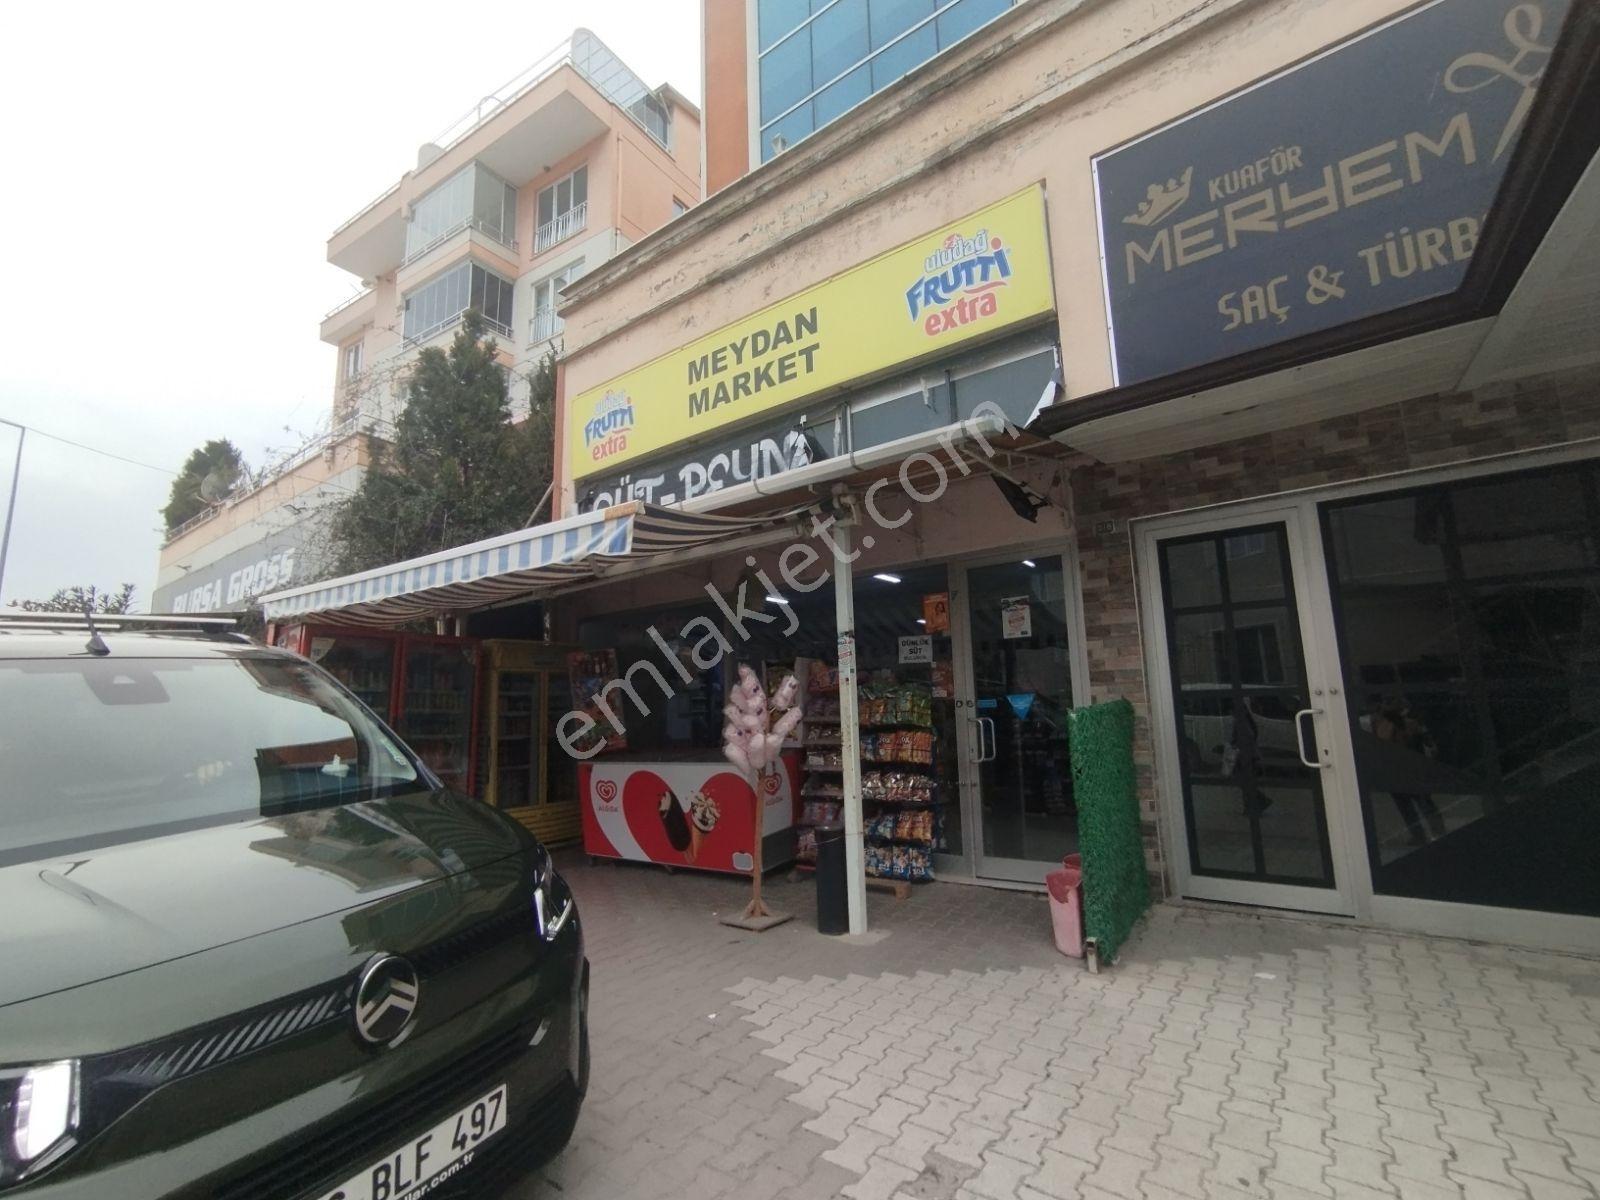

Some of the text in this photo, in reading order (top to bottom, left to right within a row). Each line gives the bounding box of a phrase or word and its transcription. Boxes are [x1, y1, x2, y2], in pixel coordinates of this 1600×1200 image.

[1125, 112, 1476, 285] MERYEM
[1208, 145, 1304, 201] KUAFÖR
[924, 228, 989, 273] uludağ
[1217, 213, 1487, 333] SAÇ & TÜRB
[687, 306, 819, 385] MEYDAN
[924, 292, 998, 337] extra
[688, 344, 821, 418] MARKET
[591, 434, 627, 461] extra
[226, 548, 296, 605] GROSS
[371, 1090, 504, 1200] BLF 497
